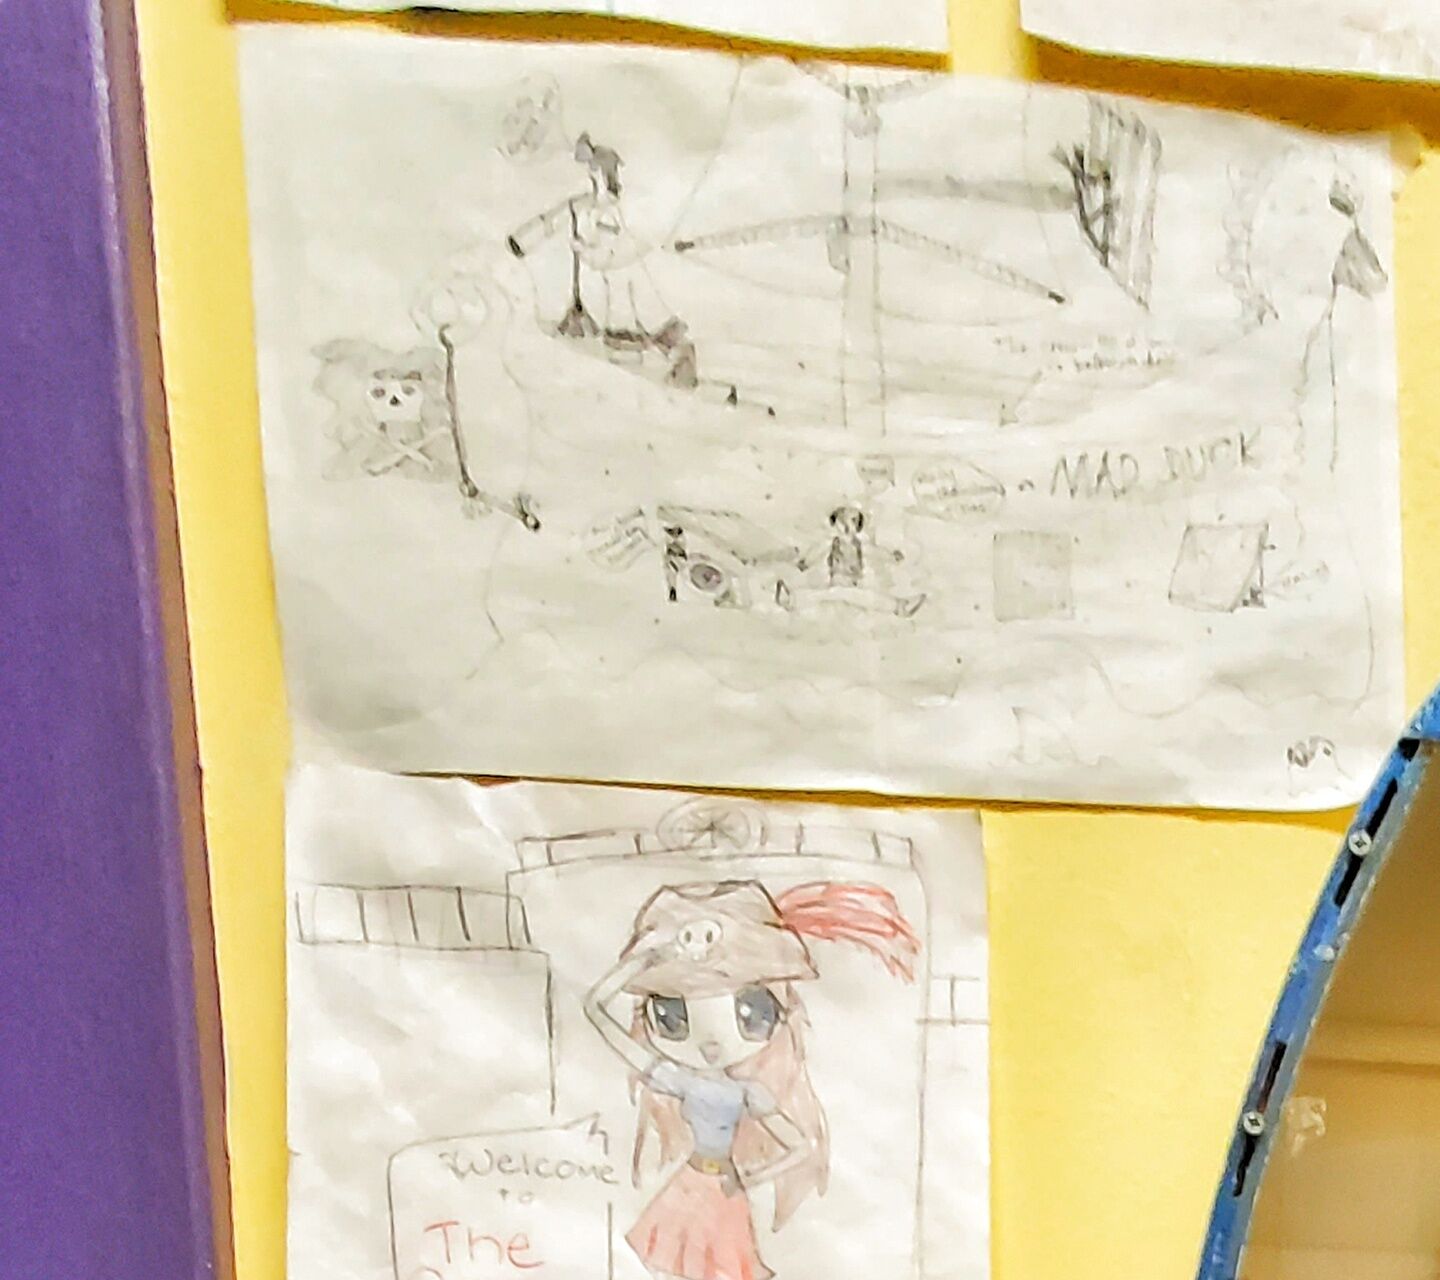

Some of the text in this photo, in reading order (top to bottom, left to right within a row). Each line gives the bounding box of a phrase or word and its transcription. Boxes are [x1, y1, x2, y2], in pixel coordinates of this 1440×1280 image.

[1050, 448, 1140, 499] MAD
[438, 1147, 622, 1186] Welcome
[423, 1219, 545, 1269] The
